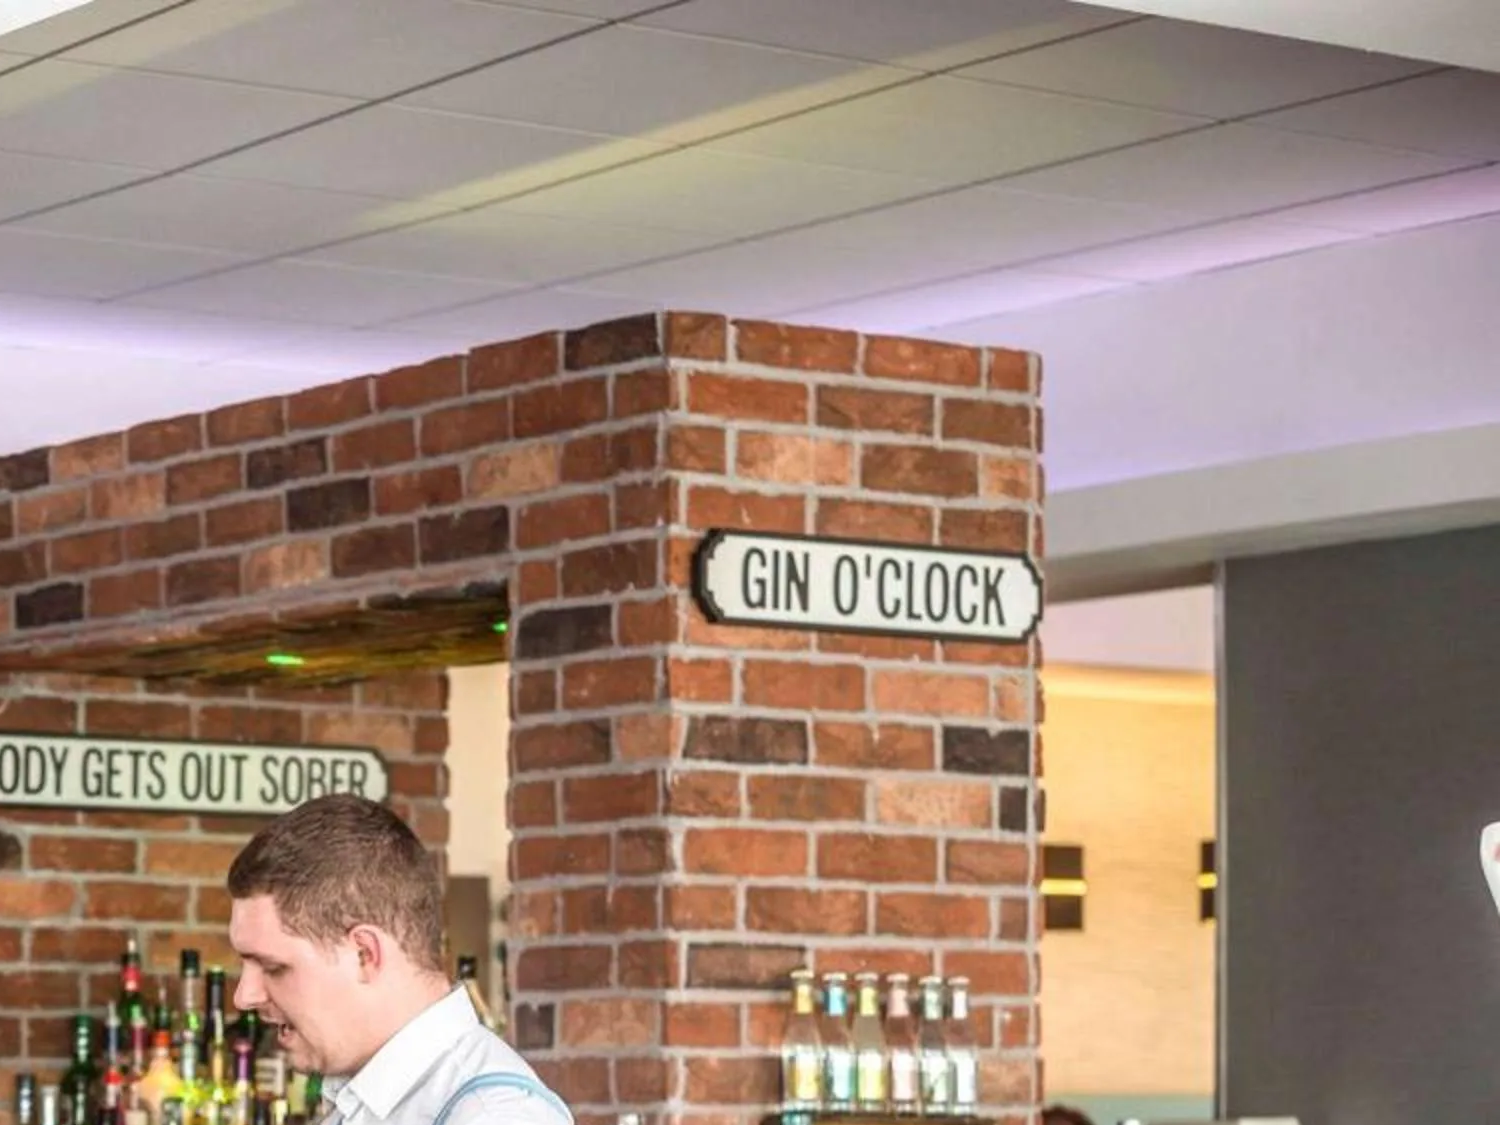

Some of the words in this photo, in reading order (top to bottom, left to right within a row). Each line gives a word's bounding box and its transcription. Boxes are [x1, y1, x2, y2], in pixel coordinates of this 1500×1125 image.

[741, 547, 810, 613] GIN
[833, 554, 1005, 627] O'CLOCK
[81, 747, 167, 801] GETS
[180, 751, 248, 803] OUT
[260, 754, 368, 805] SOBER
